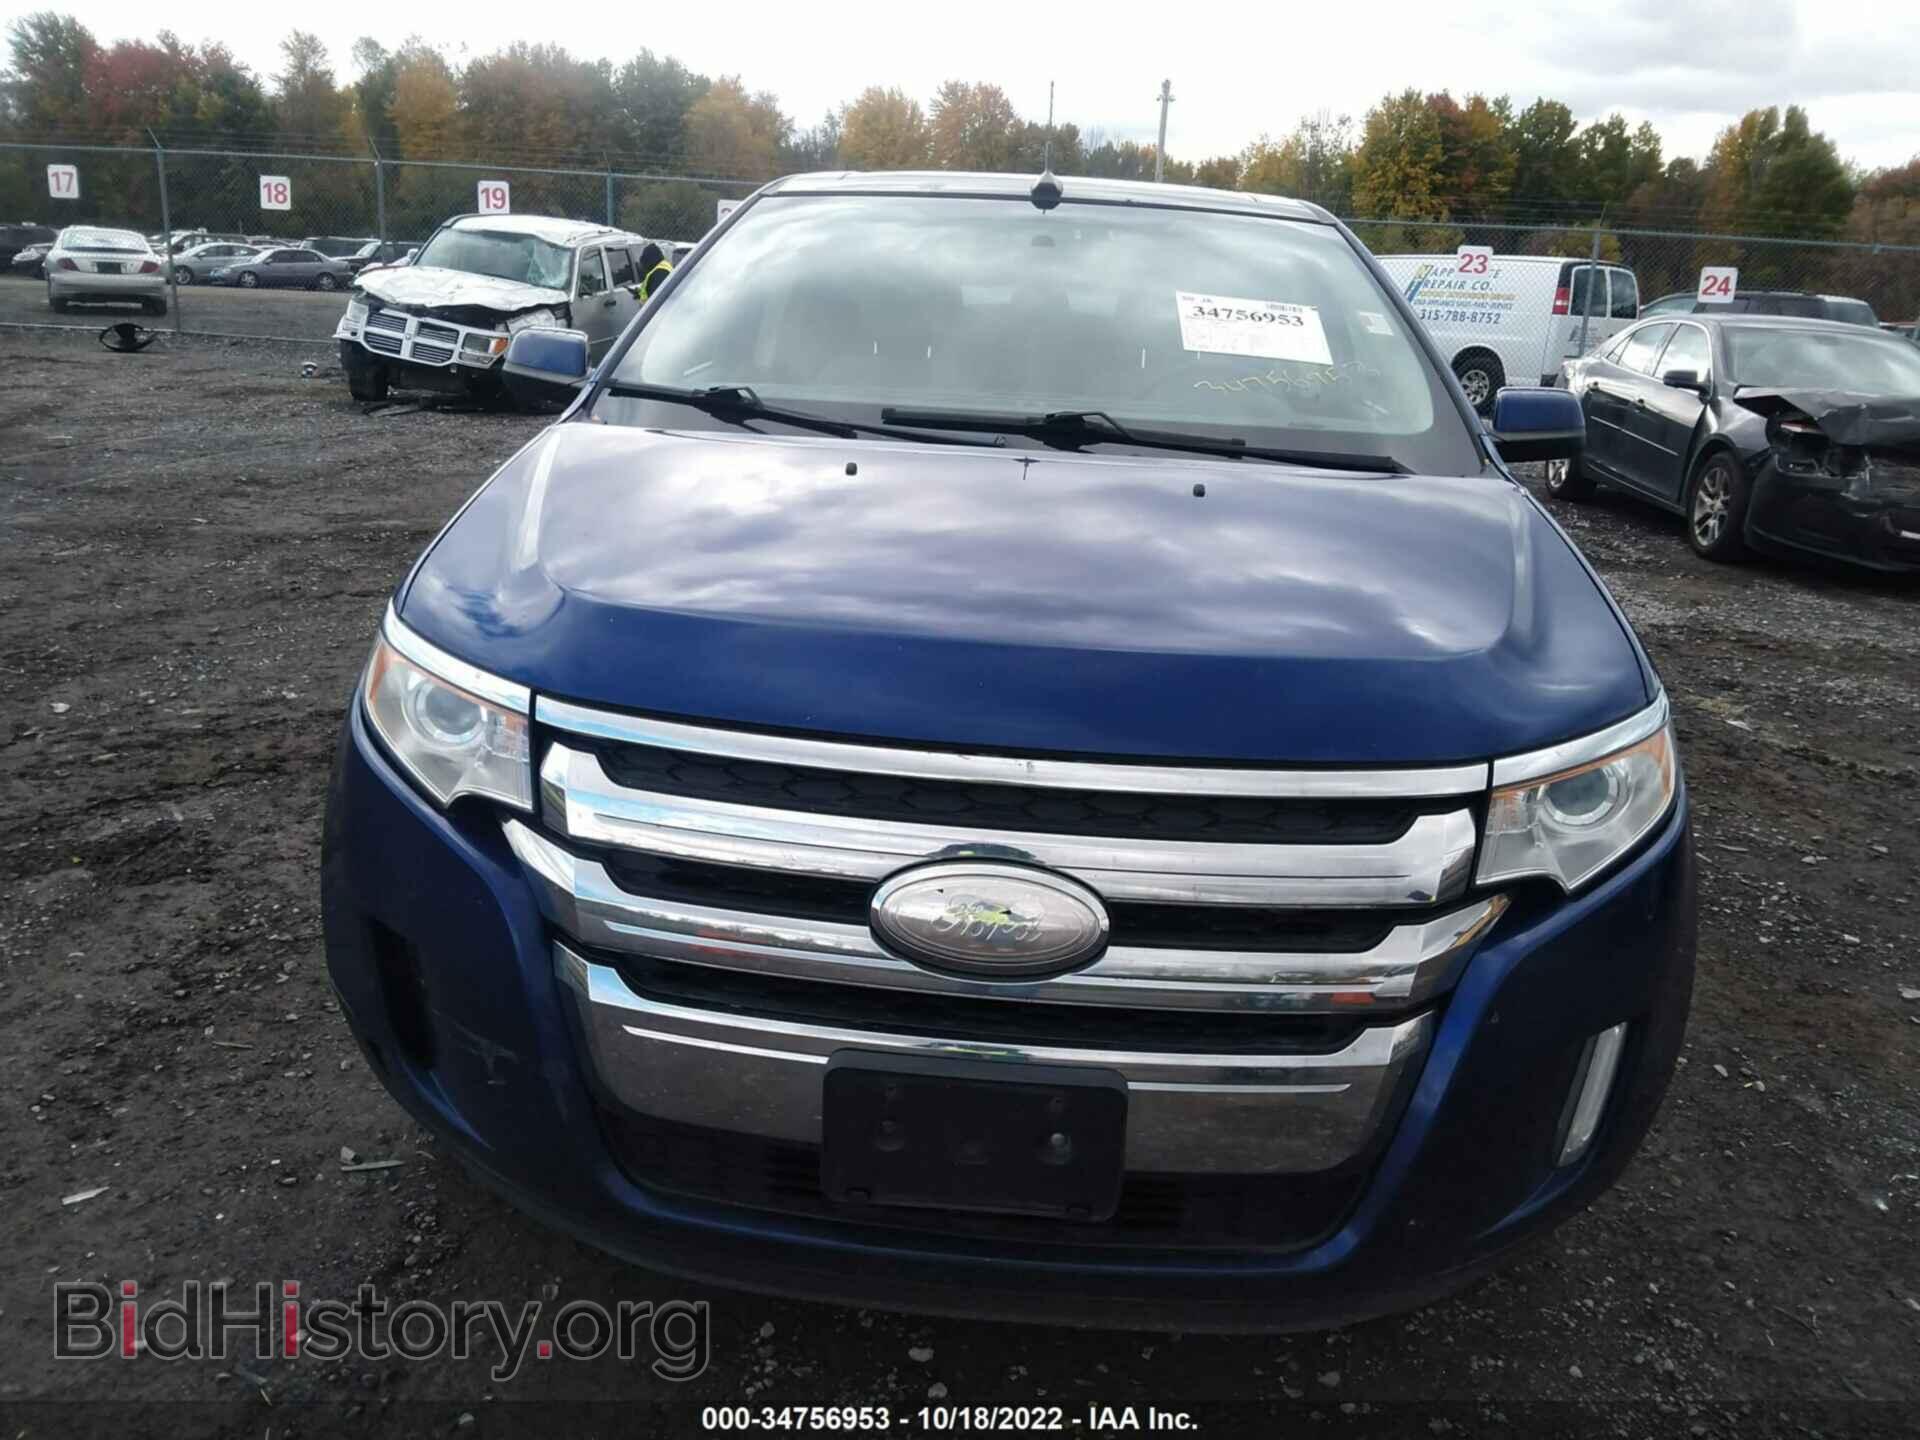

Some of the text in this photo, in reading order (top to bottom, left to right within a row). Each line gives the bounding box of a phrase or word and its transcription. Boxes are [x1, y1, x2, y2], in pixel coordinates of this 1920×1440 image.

[51, 171, 74, 193] 17
[262, 182, 288, 205] 18
[480, 187, 507, 210] 19
[1458, 253, 1489, 274] 23
[1422, 279, 1493, 291] REPAIR CO.
[1701, 274, 1732, 297] 24
[1193, 304, 1305, 327] 34756953
